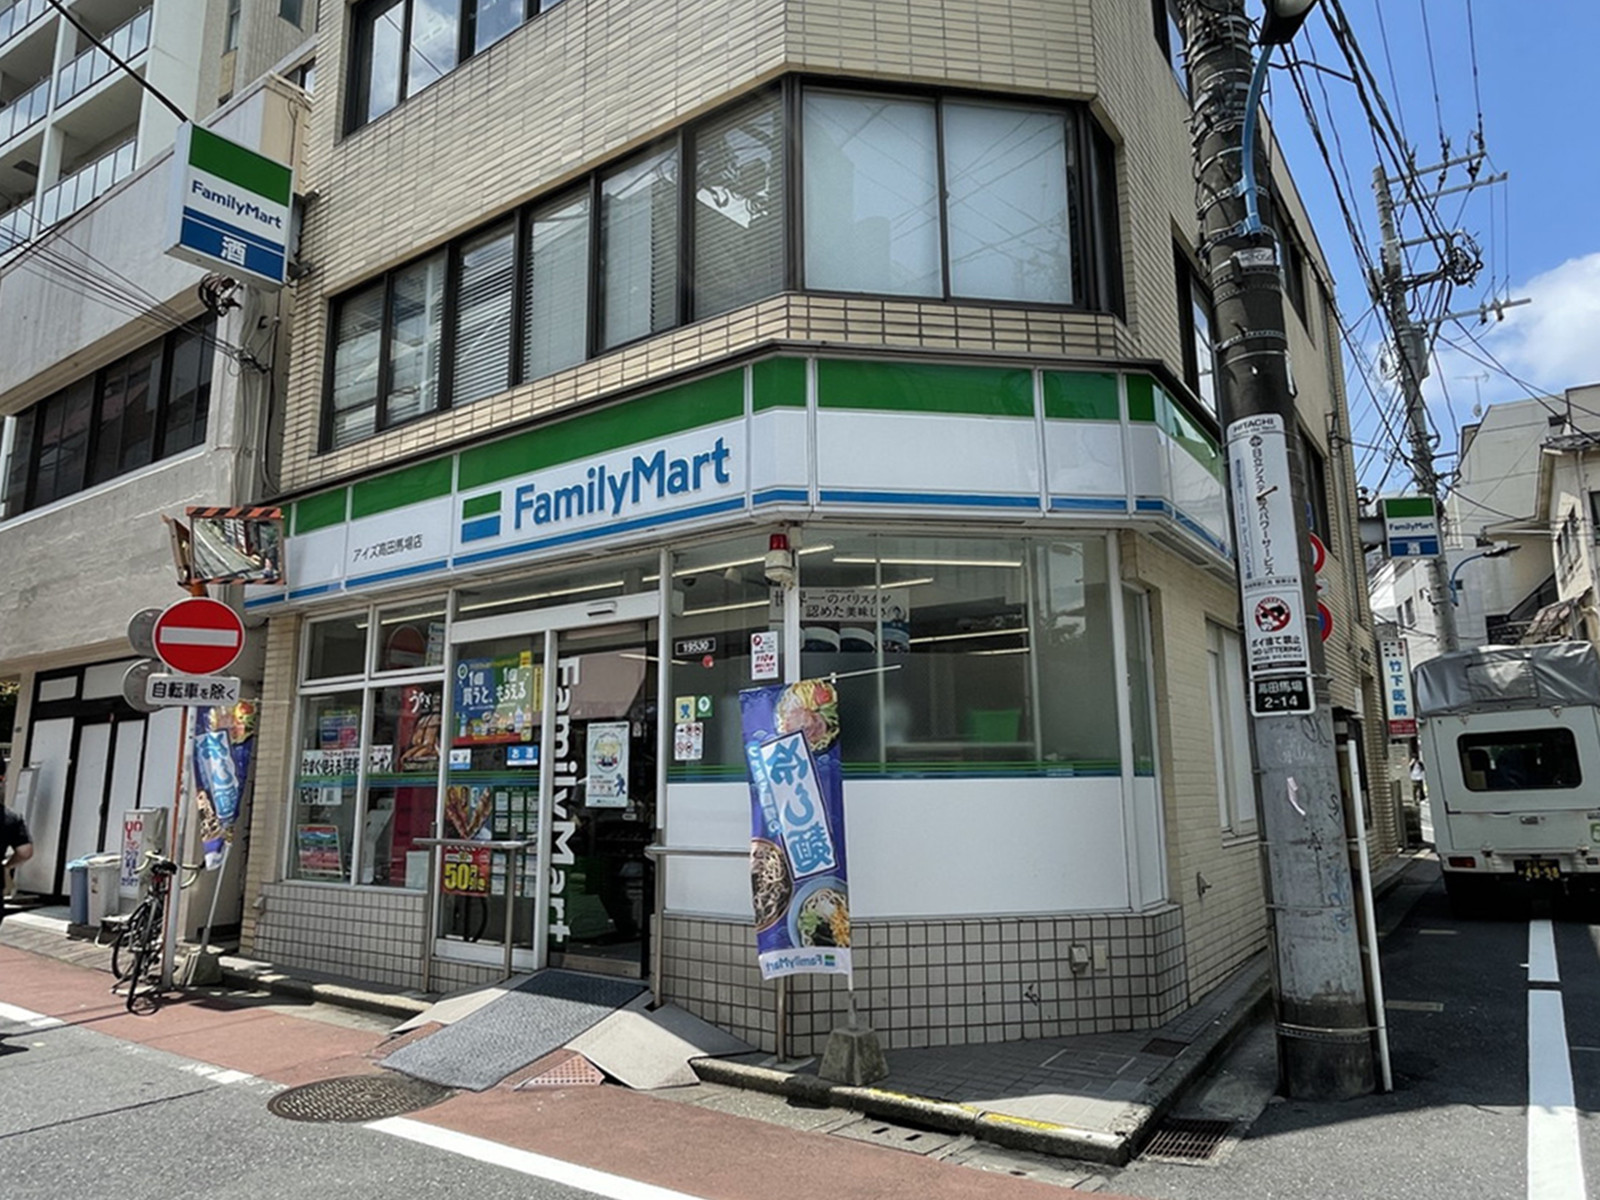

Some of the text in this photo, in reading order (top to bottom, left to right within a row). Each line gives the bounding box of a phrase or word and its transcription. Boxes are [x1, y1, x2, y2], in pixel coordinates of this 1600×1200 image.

[191, 179, 282, 230] FamilyMart
[221, 236, 247, 265] 酒
[1233, 417, 1274, 433] HITACHI
[513, 437, 731, 531] FamilyMart
[1388, 521, 1435, 532] FamilyMart
[352, 534, 423, 563] アイズ高田馬場店
[152, 682, 236, 700] 自転車を除く
[1264, 695, 1299, 709] 2-14
[1389, 659, 1408, 716] 竹下医院
